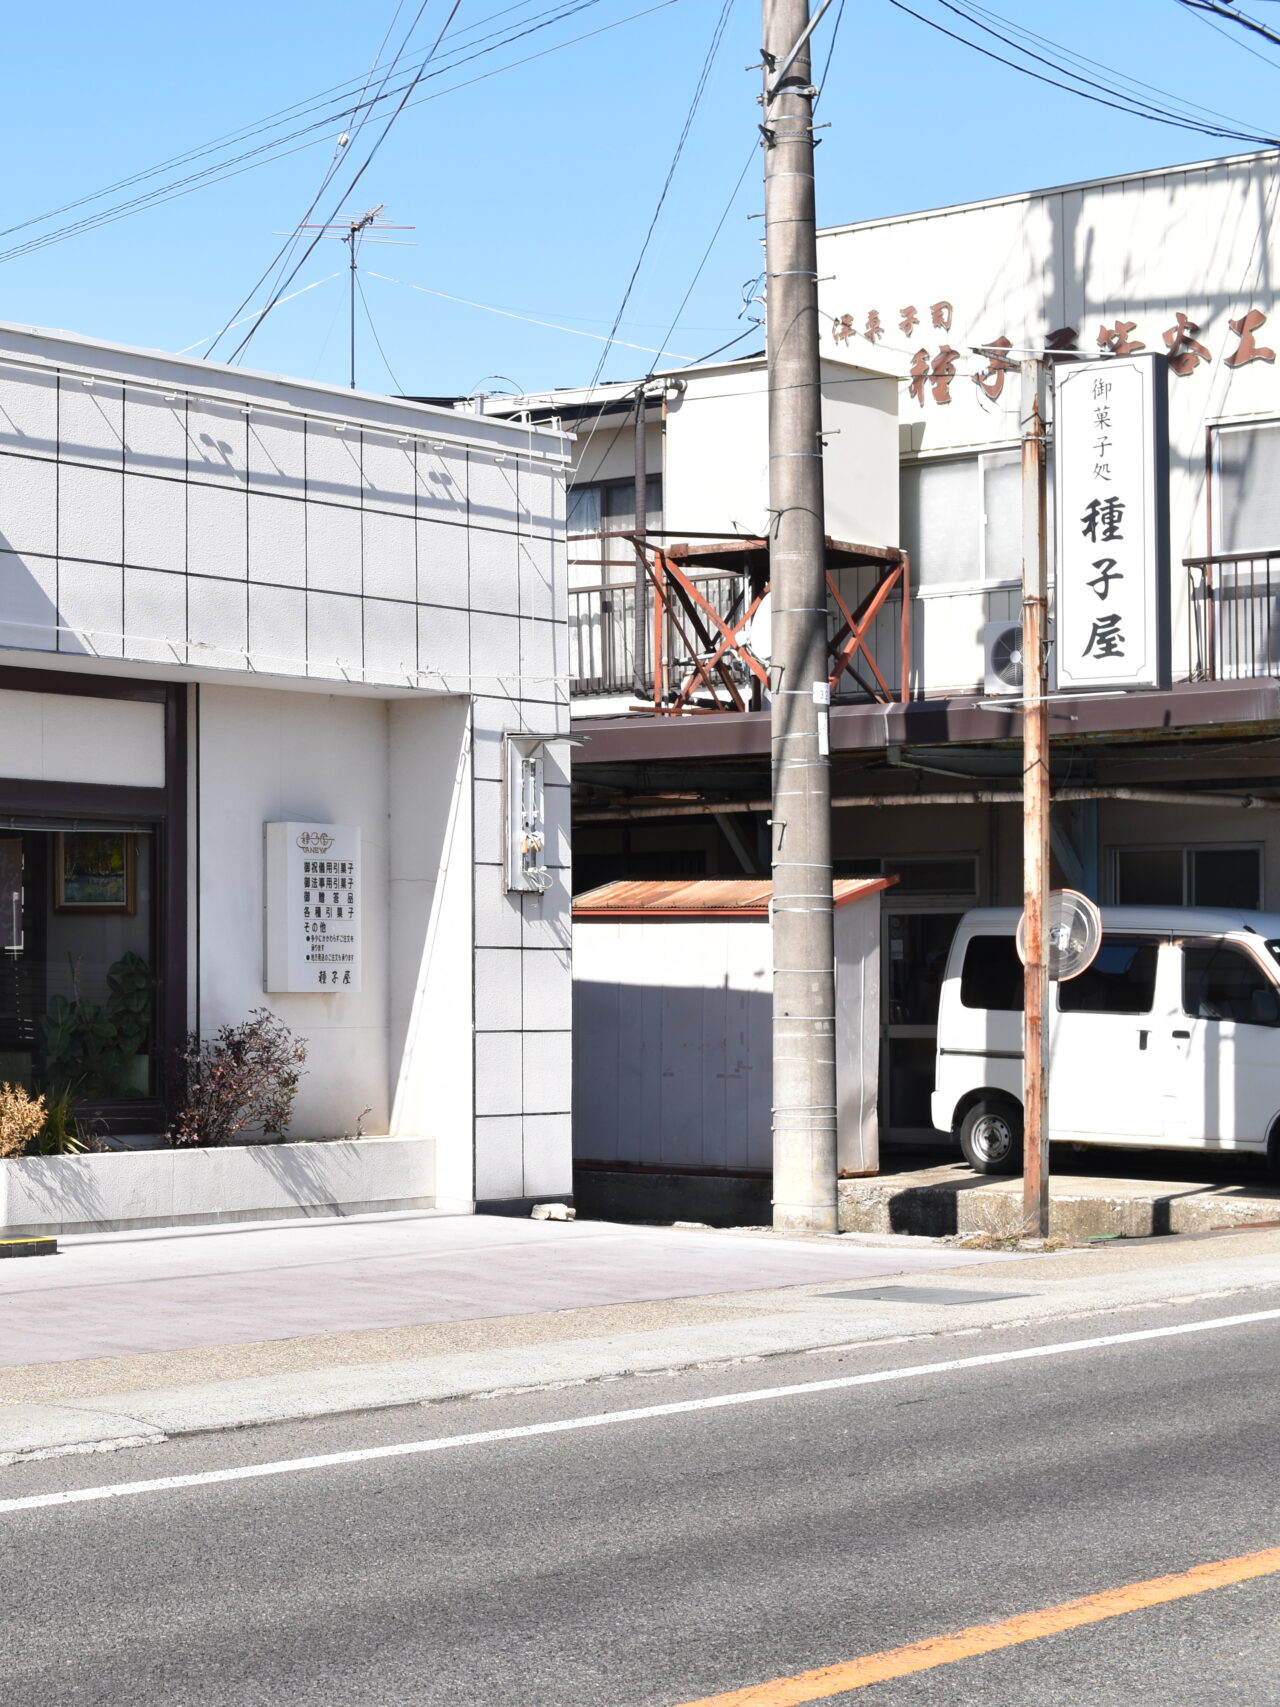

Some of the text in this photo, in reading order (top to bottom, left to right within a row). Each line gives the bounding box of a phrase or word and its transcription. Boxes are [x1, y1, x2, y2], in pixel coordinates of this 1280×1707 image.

[1092, 378, 1112, 481] 御菓子処
[1080, 495, 1126, 659] 種子屋
[304, 921, 326, 933] その他
[318, 970, 351, 984] 種子屋
